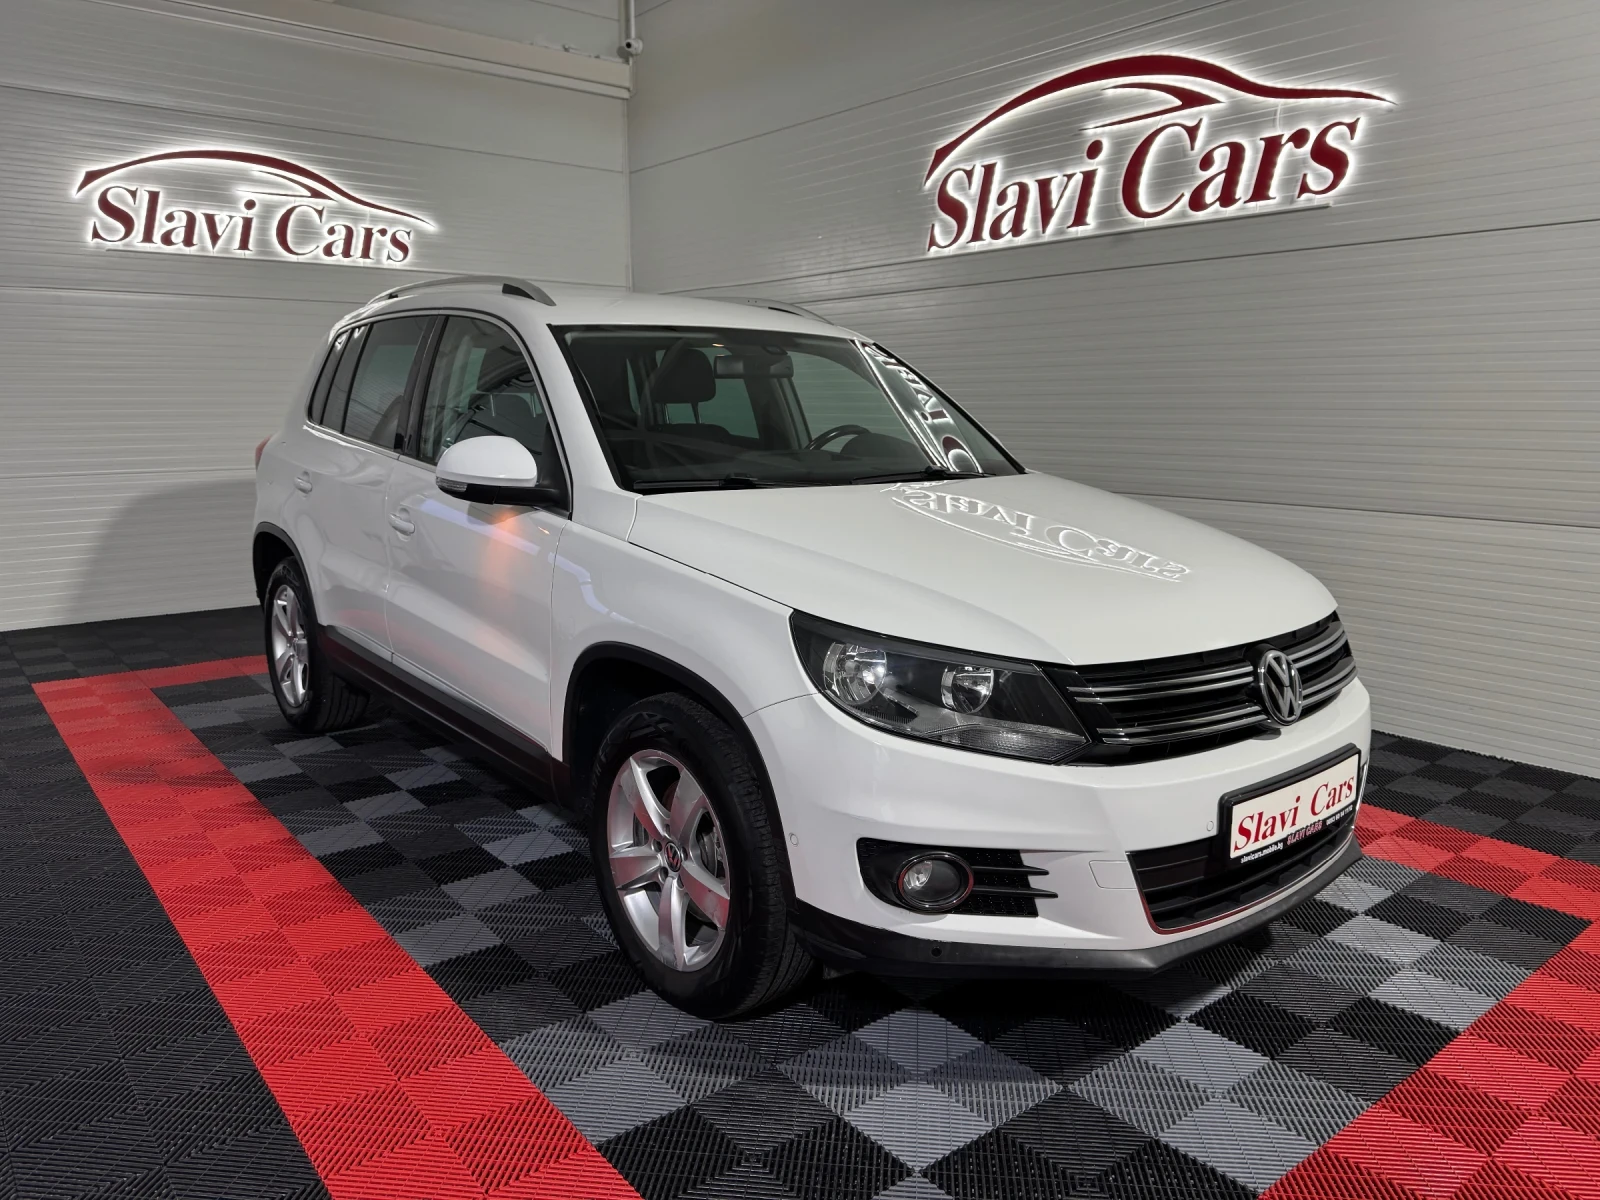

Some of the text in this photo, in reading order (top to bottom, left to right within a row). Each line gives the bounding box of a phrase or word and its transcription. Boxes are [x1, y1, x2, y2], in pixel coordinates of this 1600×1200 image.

[926, 117, 1362, 253] Slavi Cars
[91, 185, 412, 263] Slavi Cars
[1233, 795, 1301, 853] Slavi
[1310, 776, 1355, 816] Cars
[1287, 820, 1323, 846] SLAVI CARS
